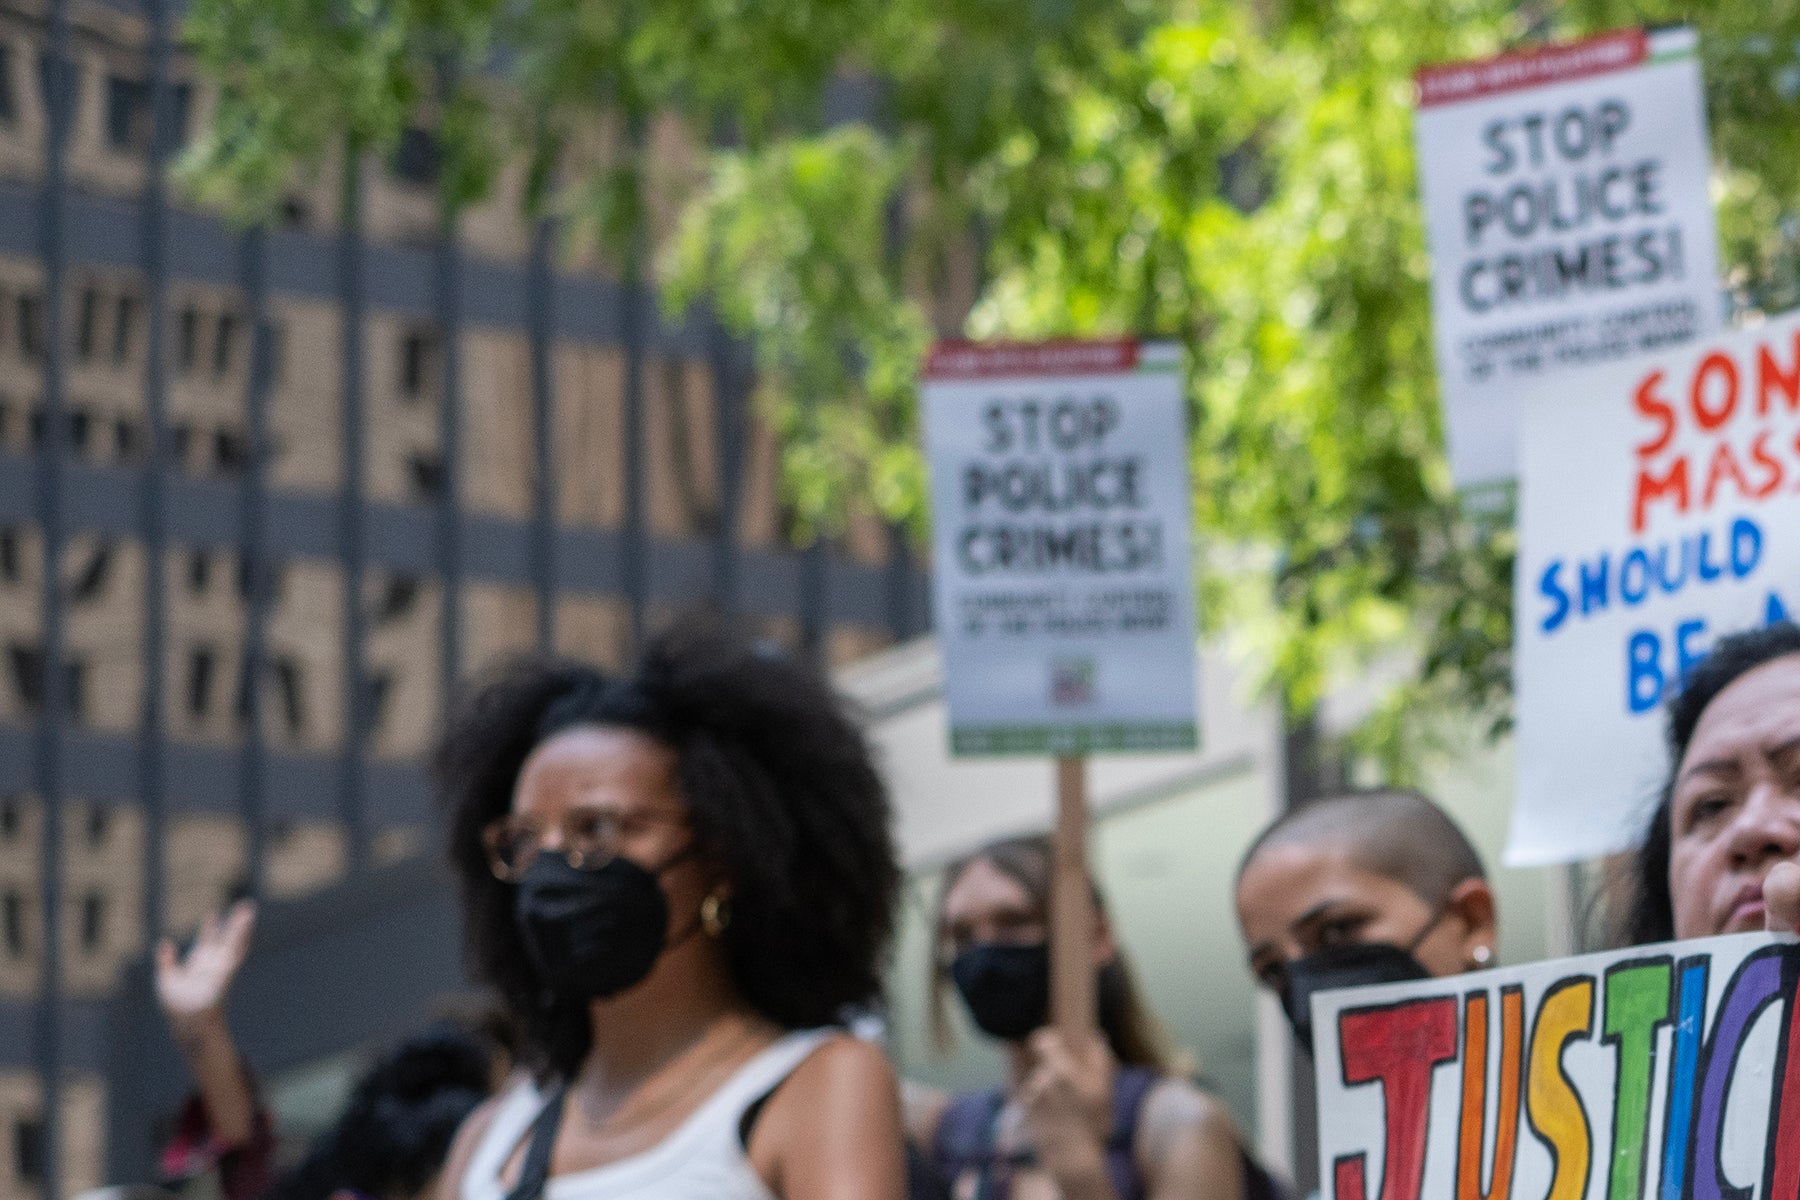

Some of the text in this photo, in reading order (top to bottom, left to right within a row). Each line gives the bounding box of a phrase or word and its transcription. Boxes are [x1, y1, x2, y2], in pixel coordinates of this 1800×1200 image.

[1483, 99, 1632, 176] STOP
[1462, 157, 1663, 246] POLICE
[1459, 224, 1685, 313] CRIMES!
[982, 398, 1120, 453] STOP
[963, 458, 1142, 512] POLICE
[1537, 516, 1765, 635] SHOULD
[1627, 618, 1708, 713] BE
